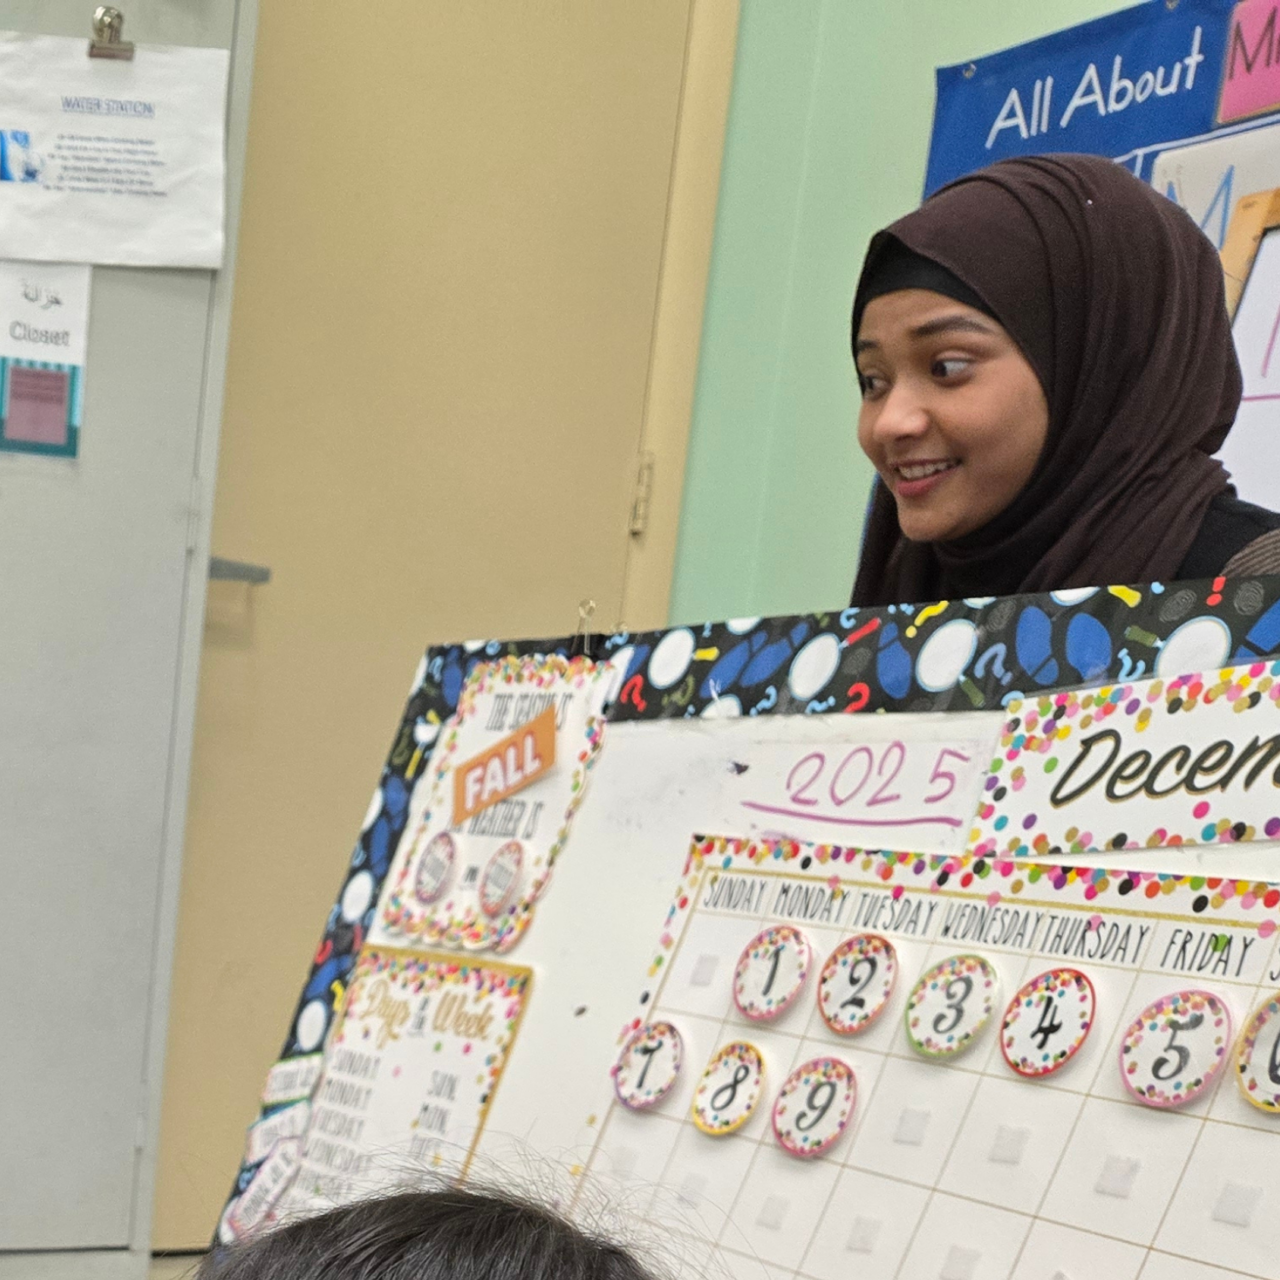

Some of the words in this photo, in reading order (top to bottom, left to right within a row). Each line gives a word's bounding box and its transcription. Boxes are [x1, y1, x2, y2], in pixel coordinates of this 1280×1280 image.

[61, 95, 101, 112] WATER
[984, 75, 1054, 149] All
[1060, 25, 1205, 128] About
[9, 320, 70, 347] Closet
[464, 733, 542, 811] FALL
[786, 740, 970, 807] 2025
[703, 875, 767, 914] SUNDAY
[772, 881, 850, 924] MONDAY
[853, 892, 938, 937] TUESDAY
[941, 902, 1044, 949] WEDNESDAY
[1040, 914, 1150, 964] THURSDAY
[1160, 928, 1256, 977] FRIDAY
[762, 945, 781, 997] 1
[840, 956, 878, 1010] 2
[432, 989, 495, 1041] Week
[933, 975, 974, 1035] 3
[1030, 995, 1063, 1050] 4
[636, 1039, 663, 1090] 7
[1151, 1013, 1205, 1081] 5
[711, 1064, 750, 1112] 8
[794, 1080, 837, 1132] 9
